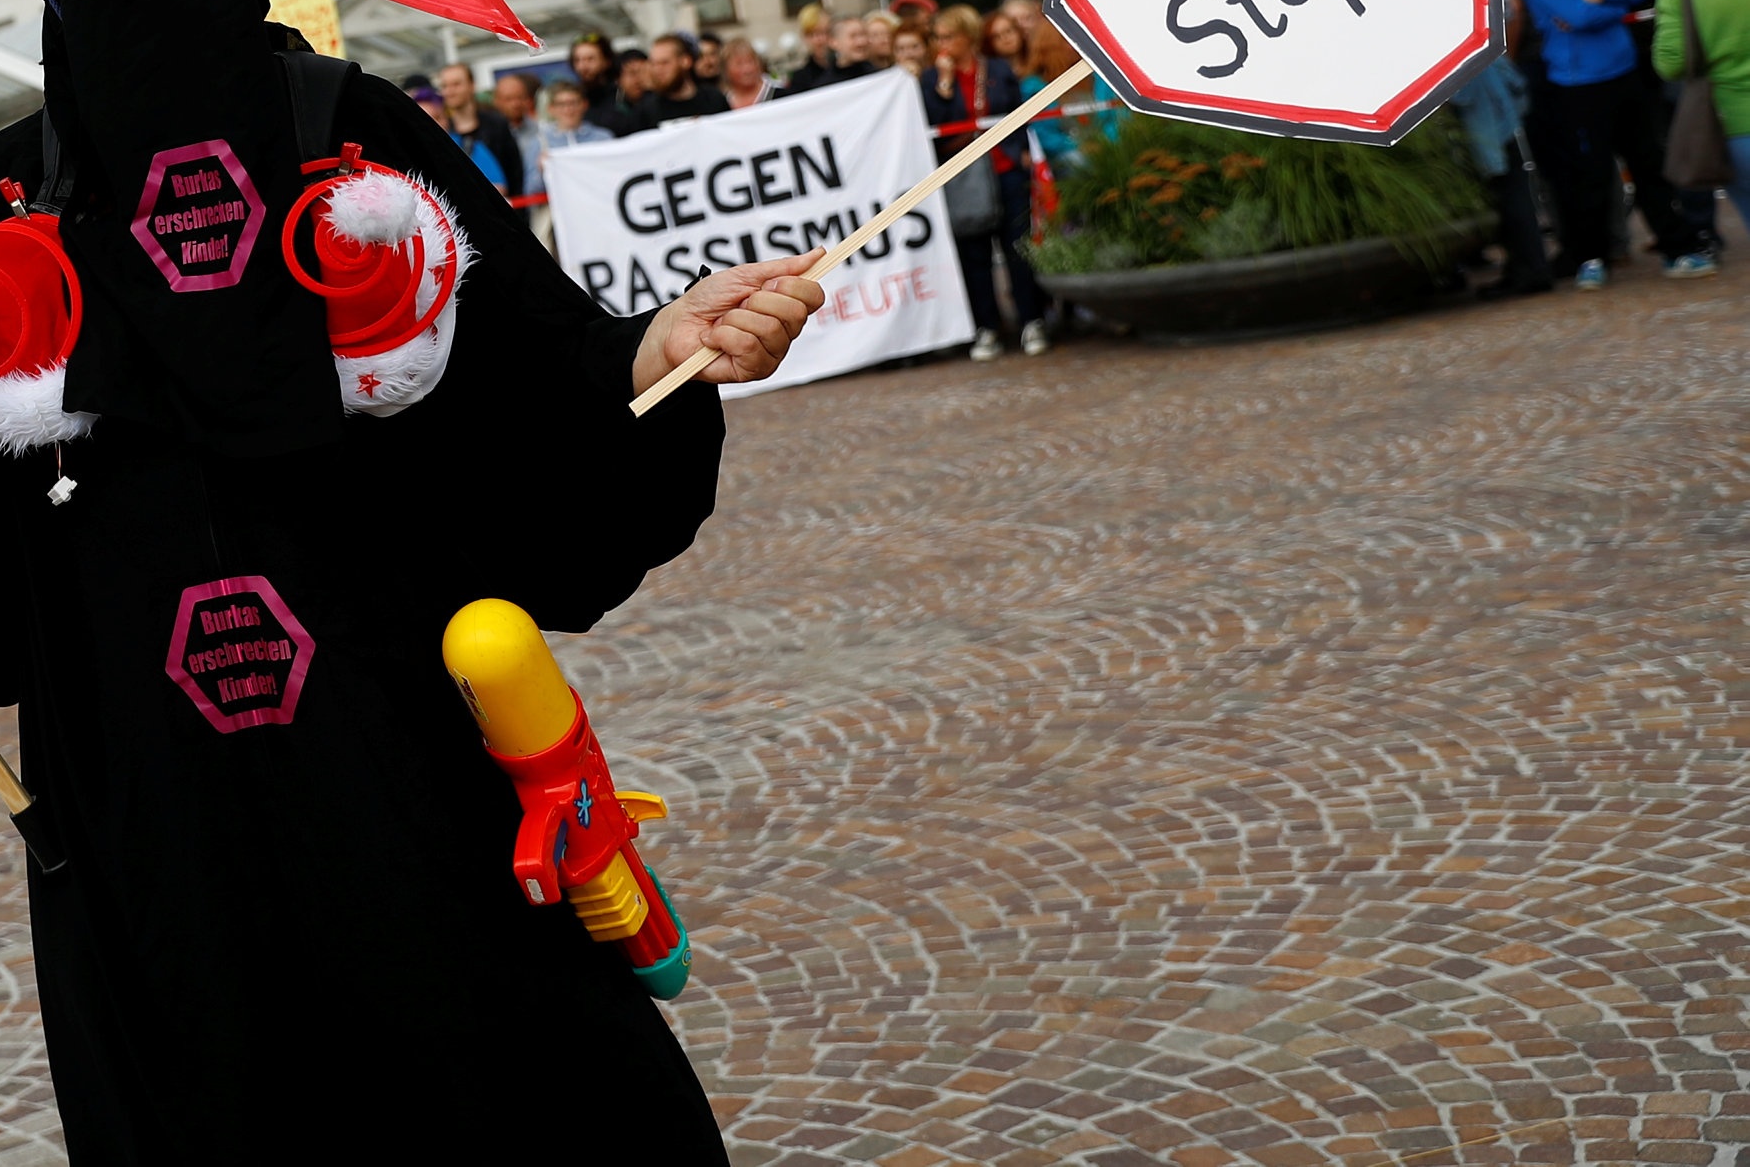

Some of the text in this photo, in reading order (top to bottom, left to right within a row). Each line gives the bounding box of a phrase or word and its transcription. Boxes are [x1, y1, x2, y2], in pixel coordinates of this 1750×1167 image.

[171, 170, 221, 197] Burkas
[617, 136, 843, 234] GEGEN
[154, 200, 244, 234] erschrecken
[181, 234, 228, 264] Kinder!
[815, 265, 938, 328] HEUTE
[200, 605, 260, 634] Burkas
[188, 638, 291, 674] erschrecken
[217, 673, 277, 703] Kinder!
